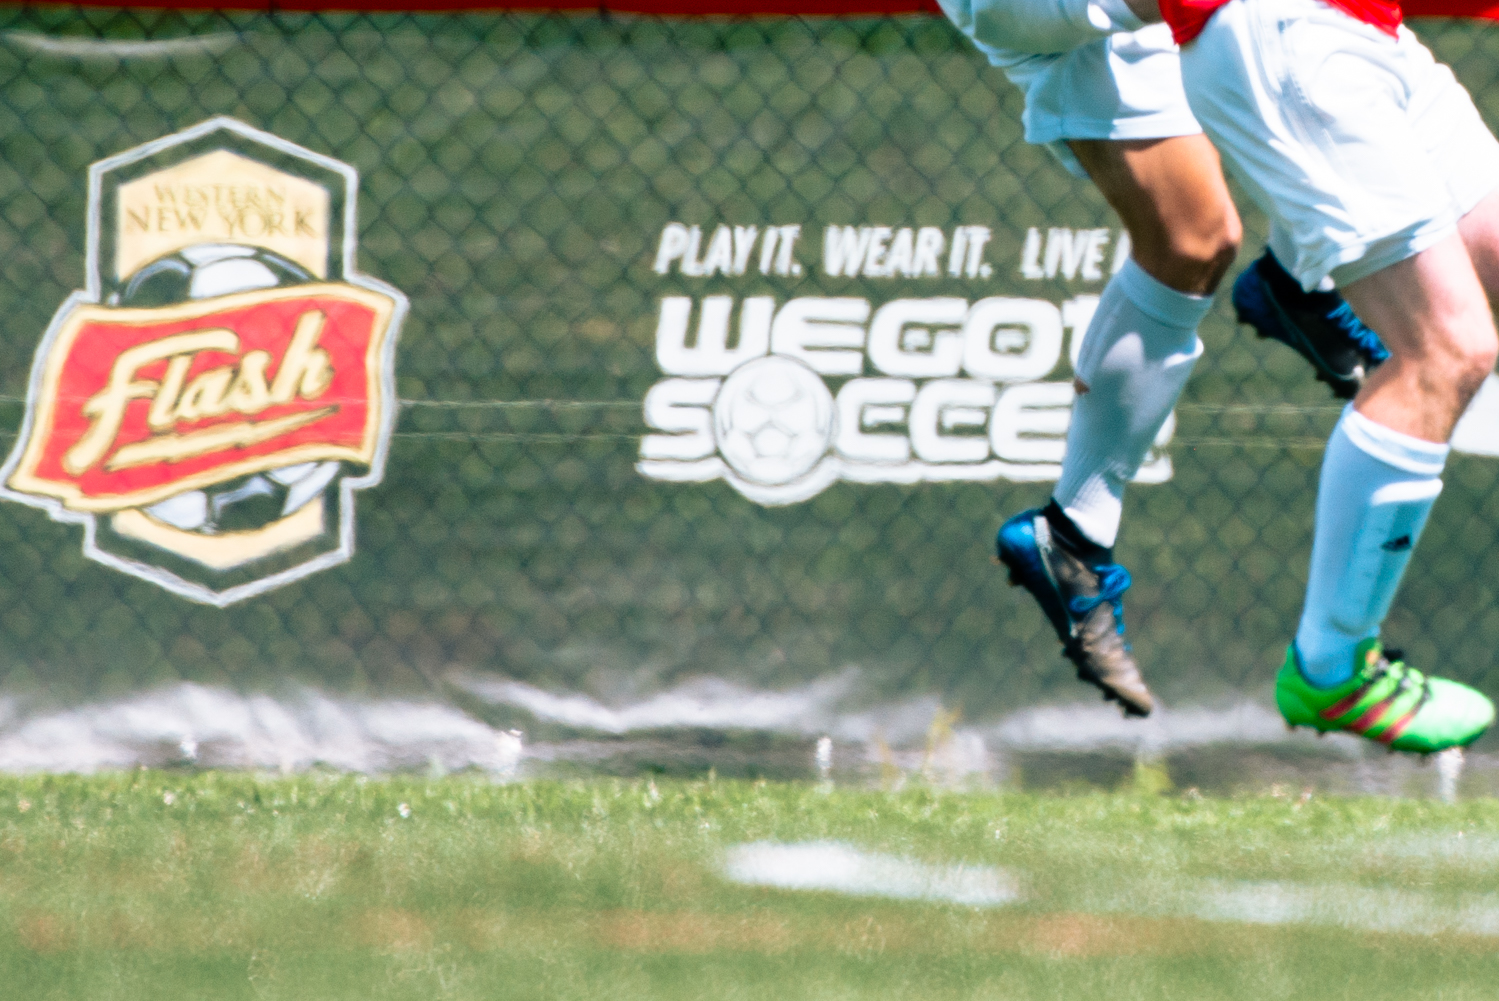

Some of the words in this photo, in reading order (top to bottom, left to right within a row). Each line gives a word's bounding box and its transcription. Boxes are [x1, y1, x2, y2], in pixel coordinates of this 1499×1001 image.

[125, 204, 208, 233] NEW
[216, 206, 319, 239] YORK
[653, 222, 757, 276] PLAY
[823, 225, 947, 278] WEAR
[1020, 227, 1110, 281] LIVE
[636, 354, 1173, 504] SOCCE
